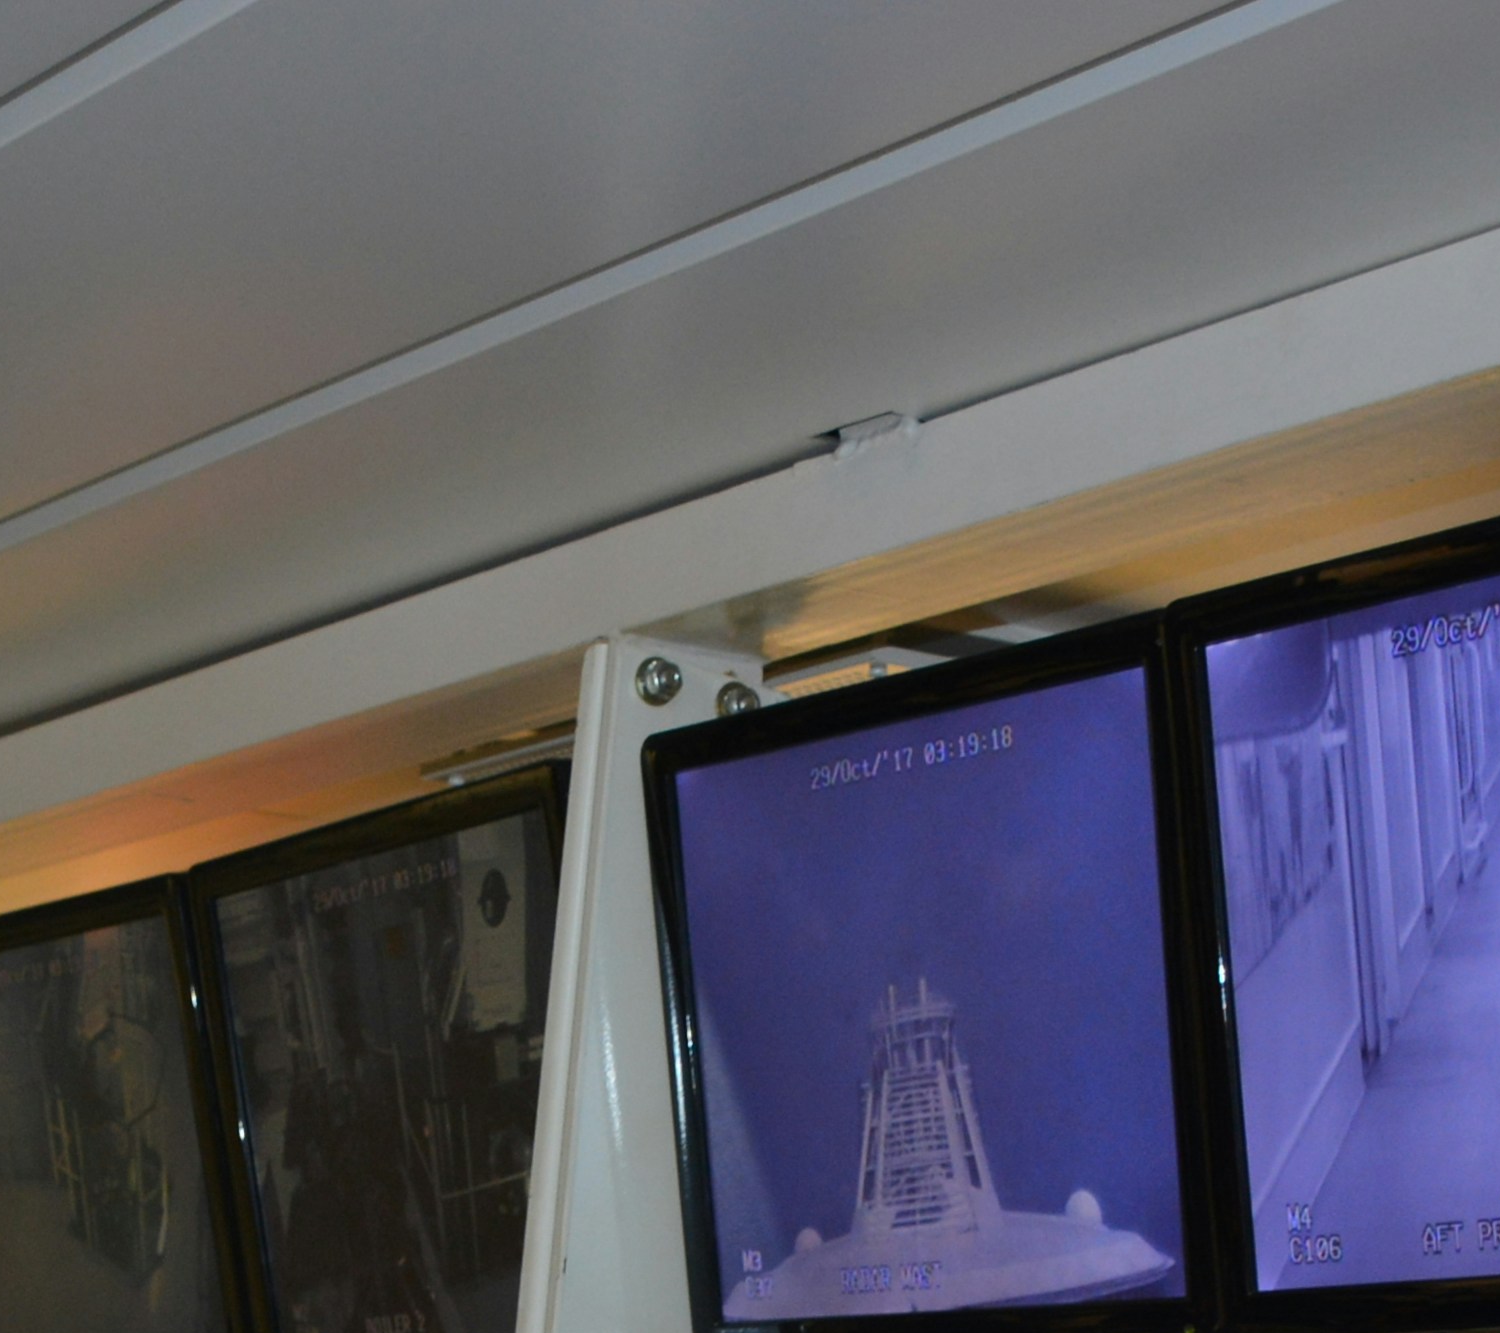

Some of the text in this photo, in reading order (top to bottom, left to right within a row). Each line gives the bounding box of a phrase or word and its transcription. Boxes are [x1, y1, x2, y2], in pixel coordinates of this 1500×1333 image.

[924, 725, 1012, 764] 03:19:18
[1287, 1204, 1312, 1231] M4
[1290, 1236, 1342, 1263] C106
[1422, 1222, 1463, 1254] AFT
